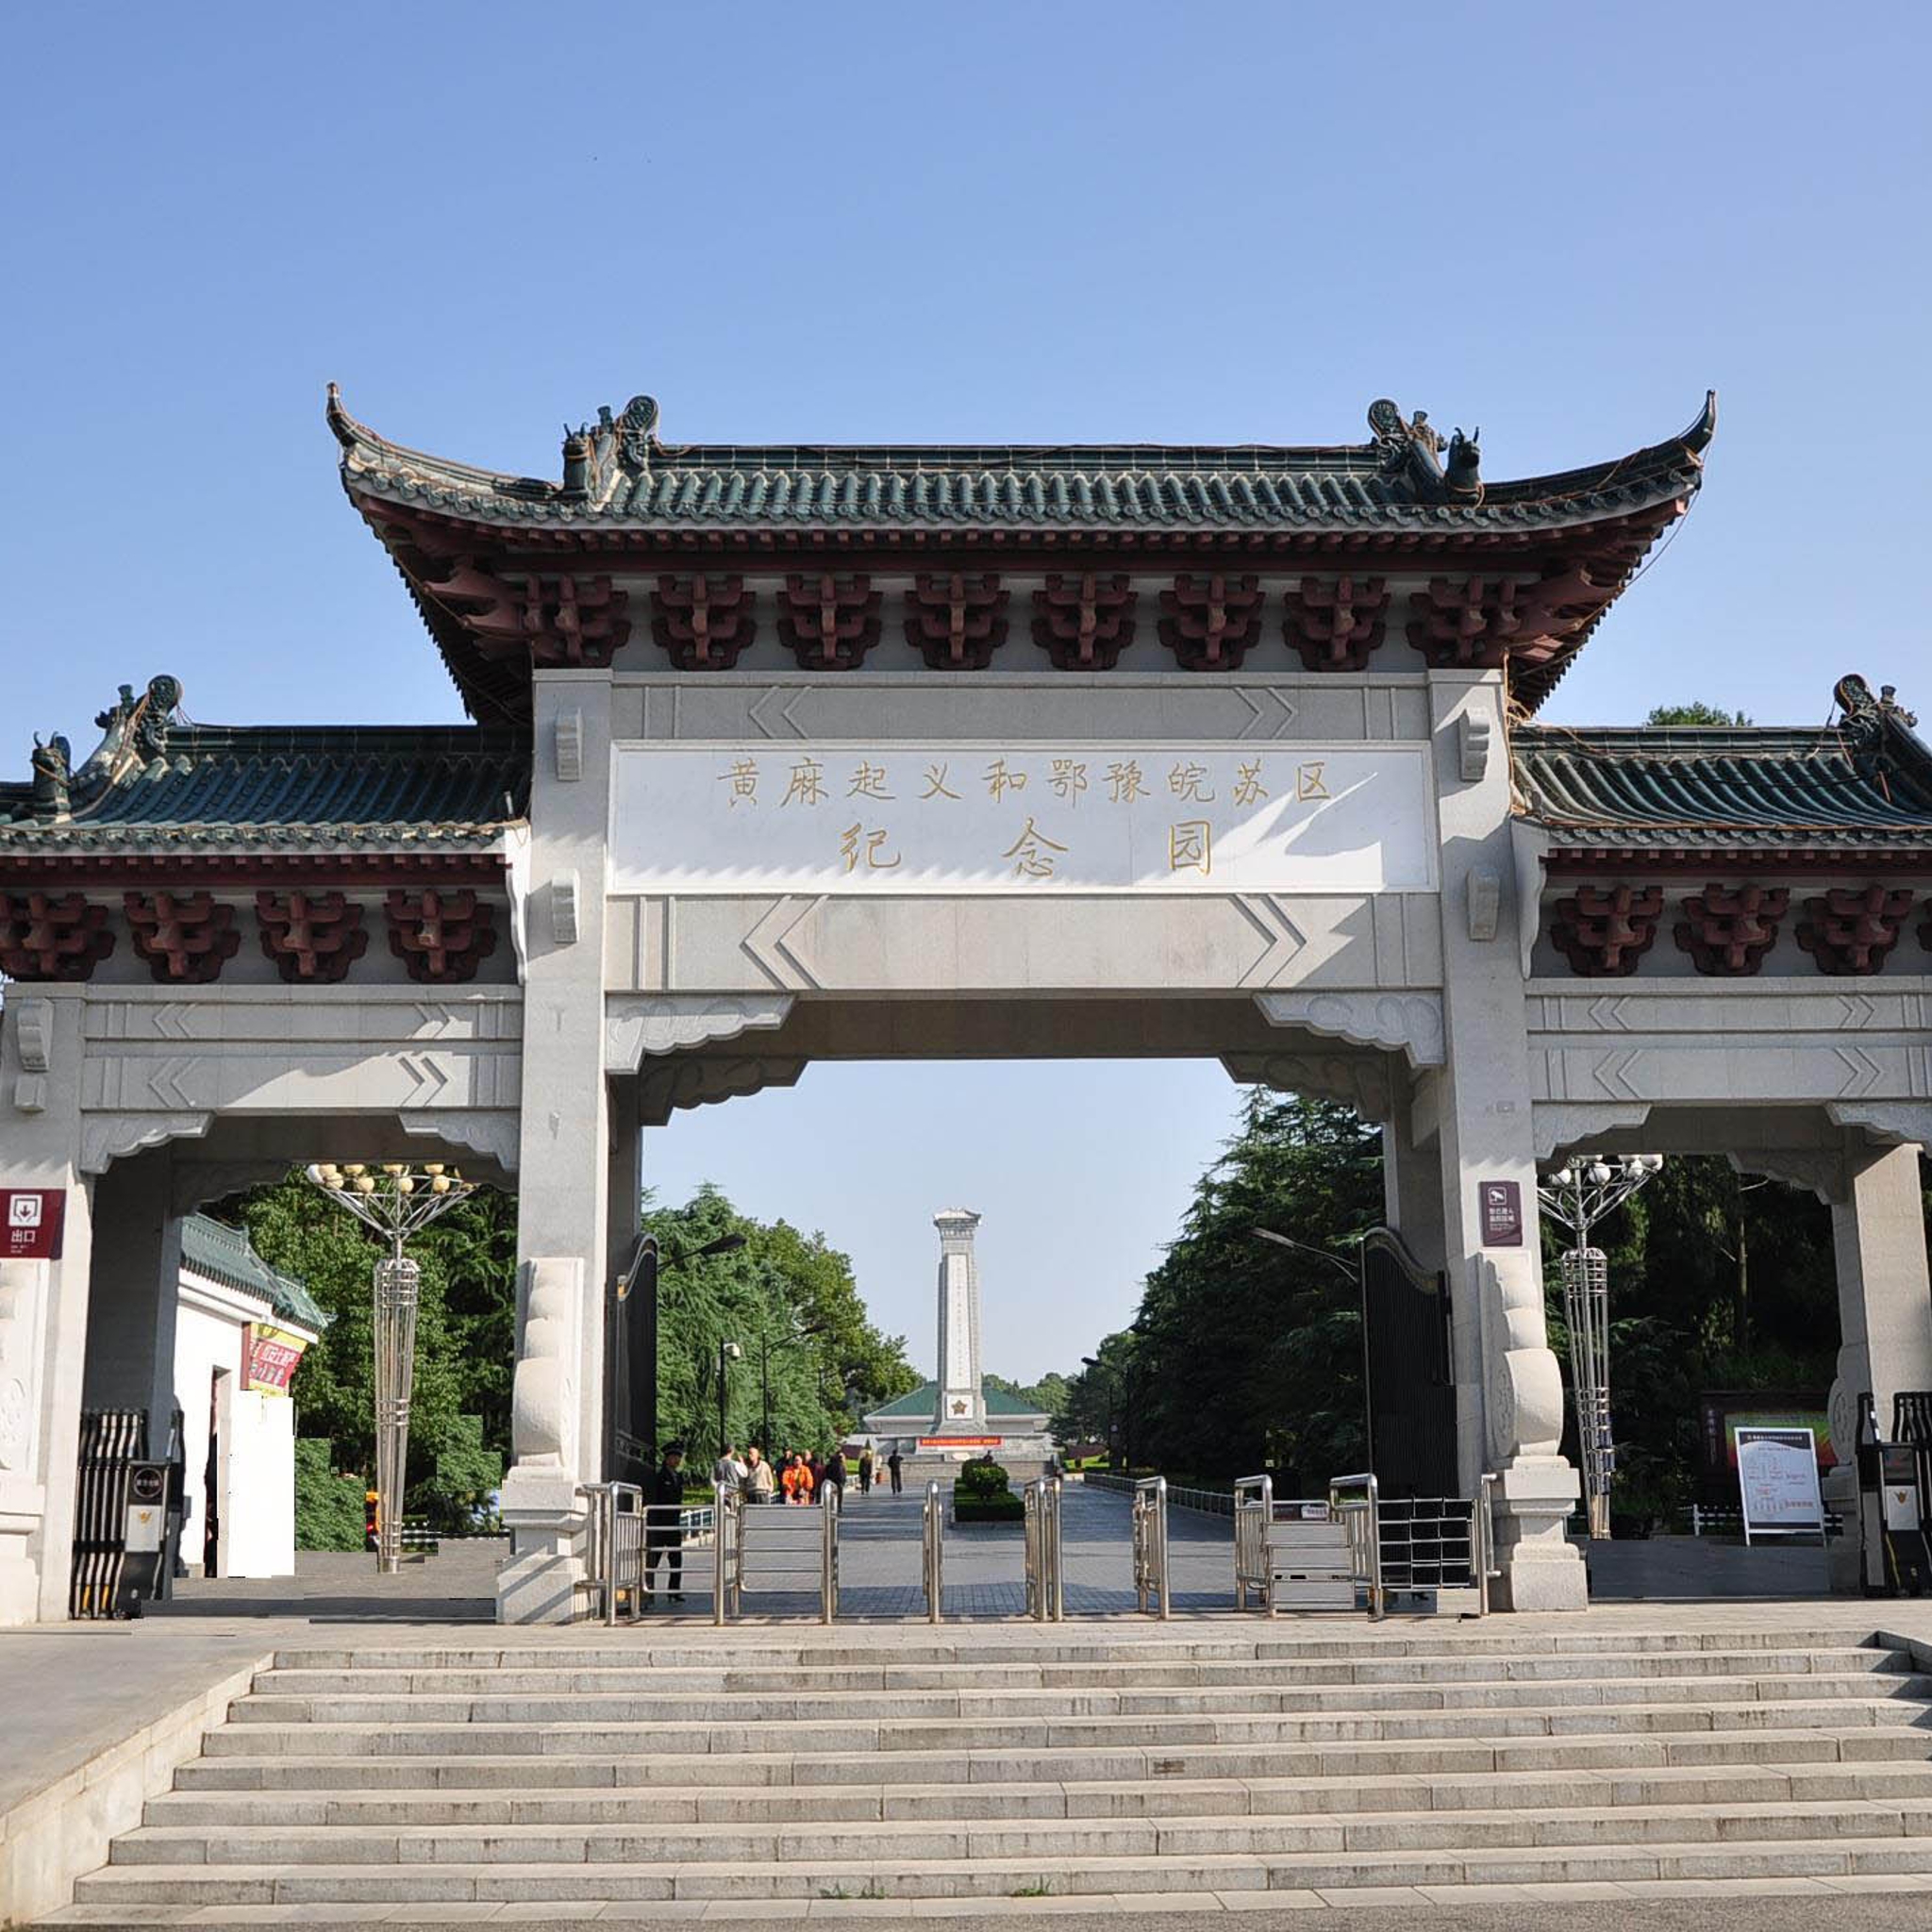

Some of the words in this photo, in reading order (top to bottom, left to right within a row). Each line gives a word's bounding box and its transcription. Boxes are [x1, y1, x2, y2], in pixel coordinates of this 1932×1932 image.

[717, 757, 1330, 808] 黄麻起义和鄂豫皖苏区
[839, 817, 1211, 879] 纪念园
[11, 1229, 36, 1243] 出口
